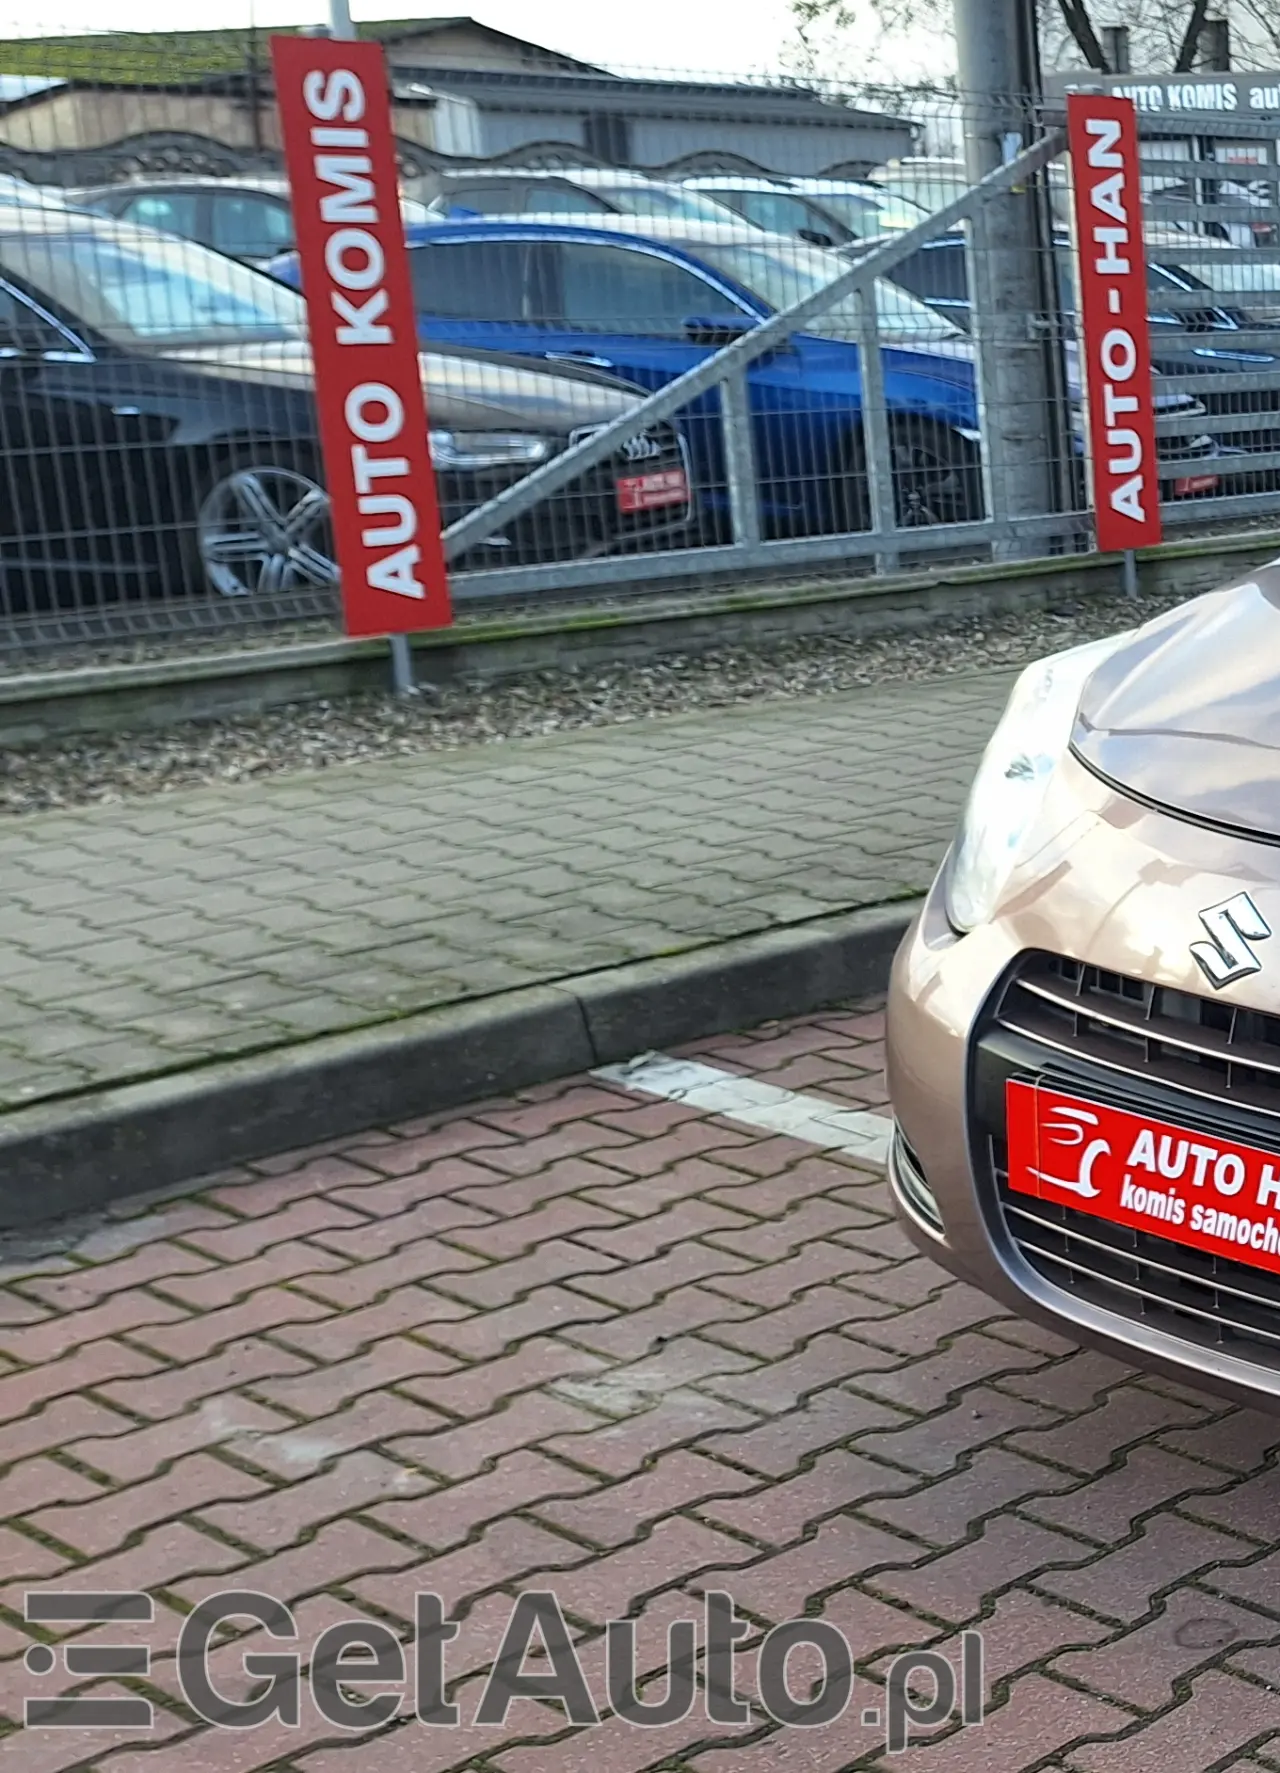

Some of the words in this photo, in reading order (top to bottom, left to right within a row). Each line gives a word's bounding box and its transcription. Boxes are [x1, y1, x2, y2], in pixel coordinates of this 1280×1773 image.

[1166, 83, 1237, 111] KOMIS
[303, 68, 394, 345] KOMIS
[1085, 118, 1130, 274] HAN
[344, 382, 426, 599] AUTO
[1100, 328, 1145, 522] AUTO
[1120, 1173, 1186, 1225] komis
[1125, 1129, 1245, 1196] AUTO
